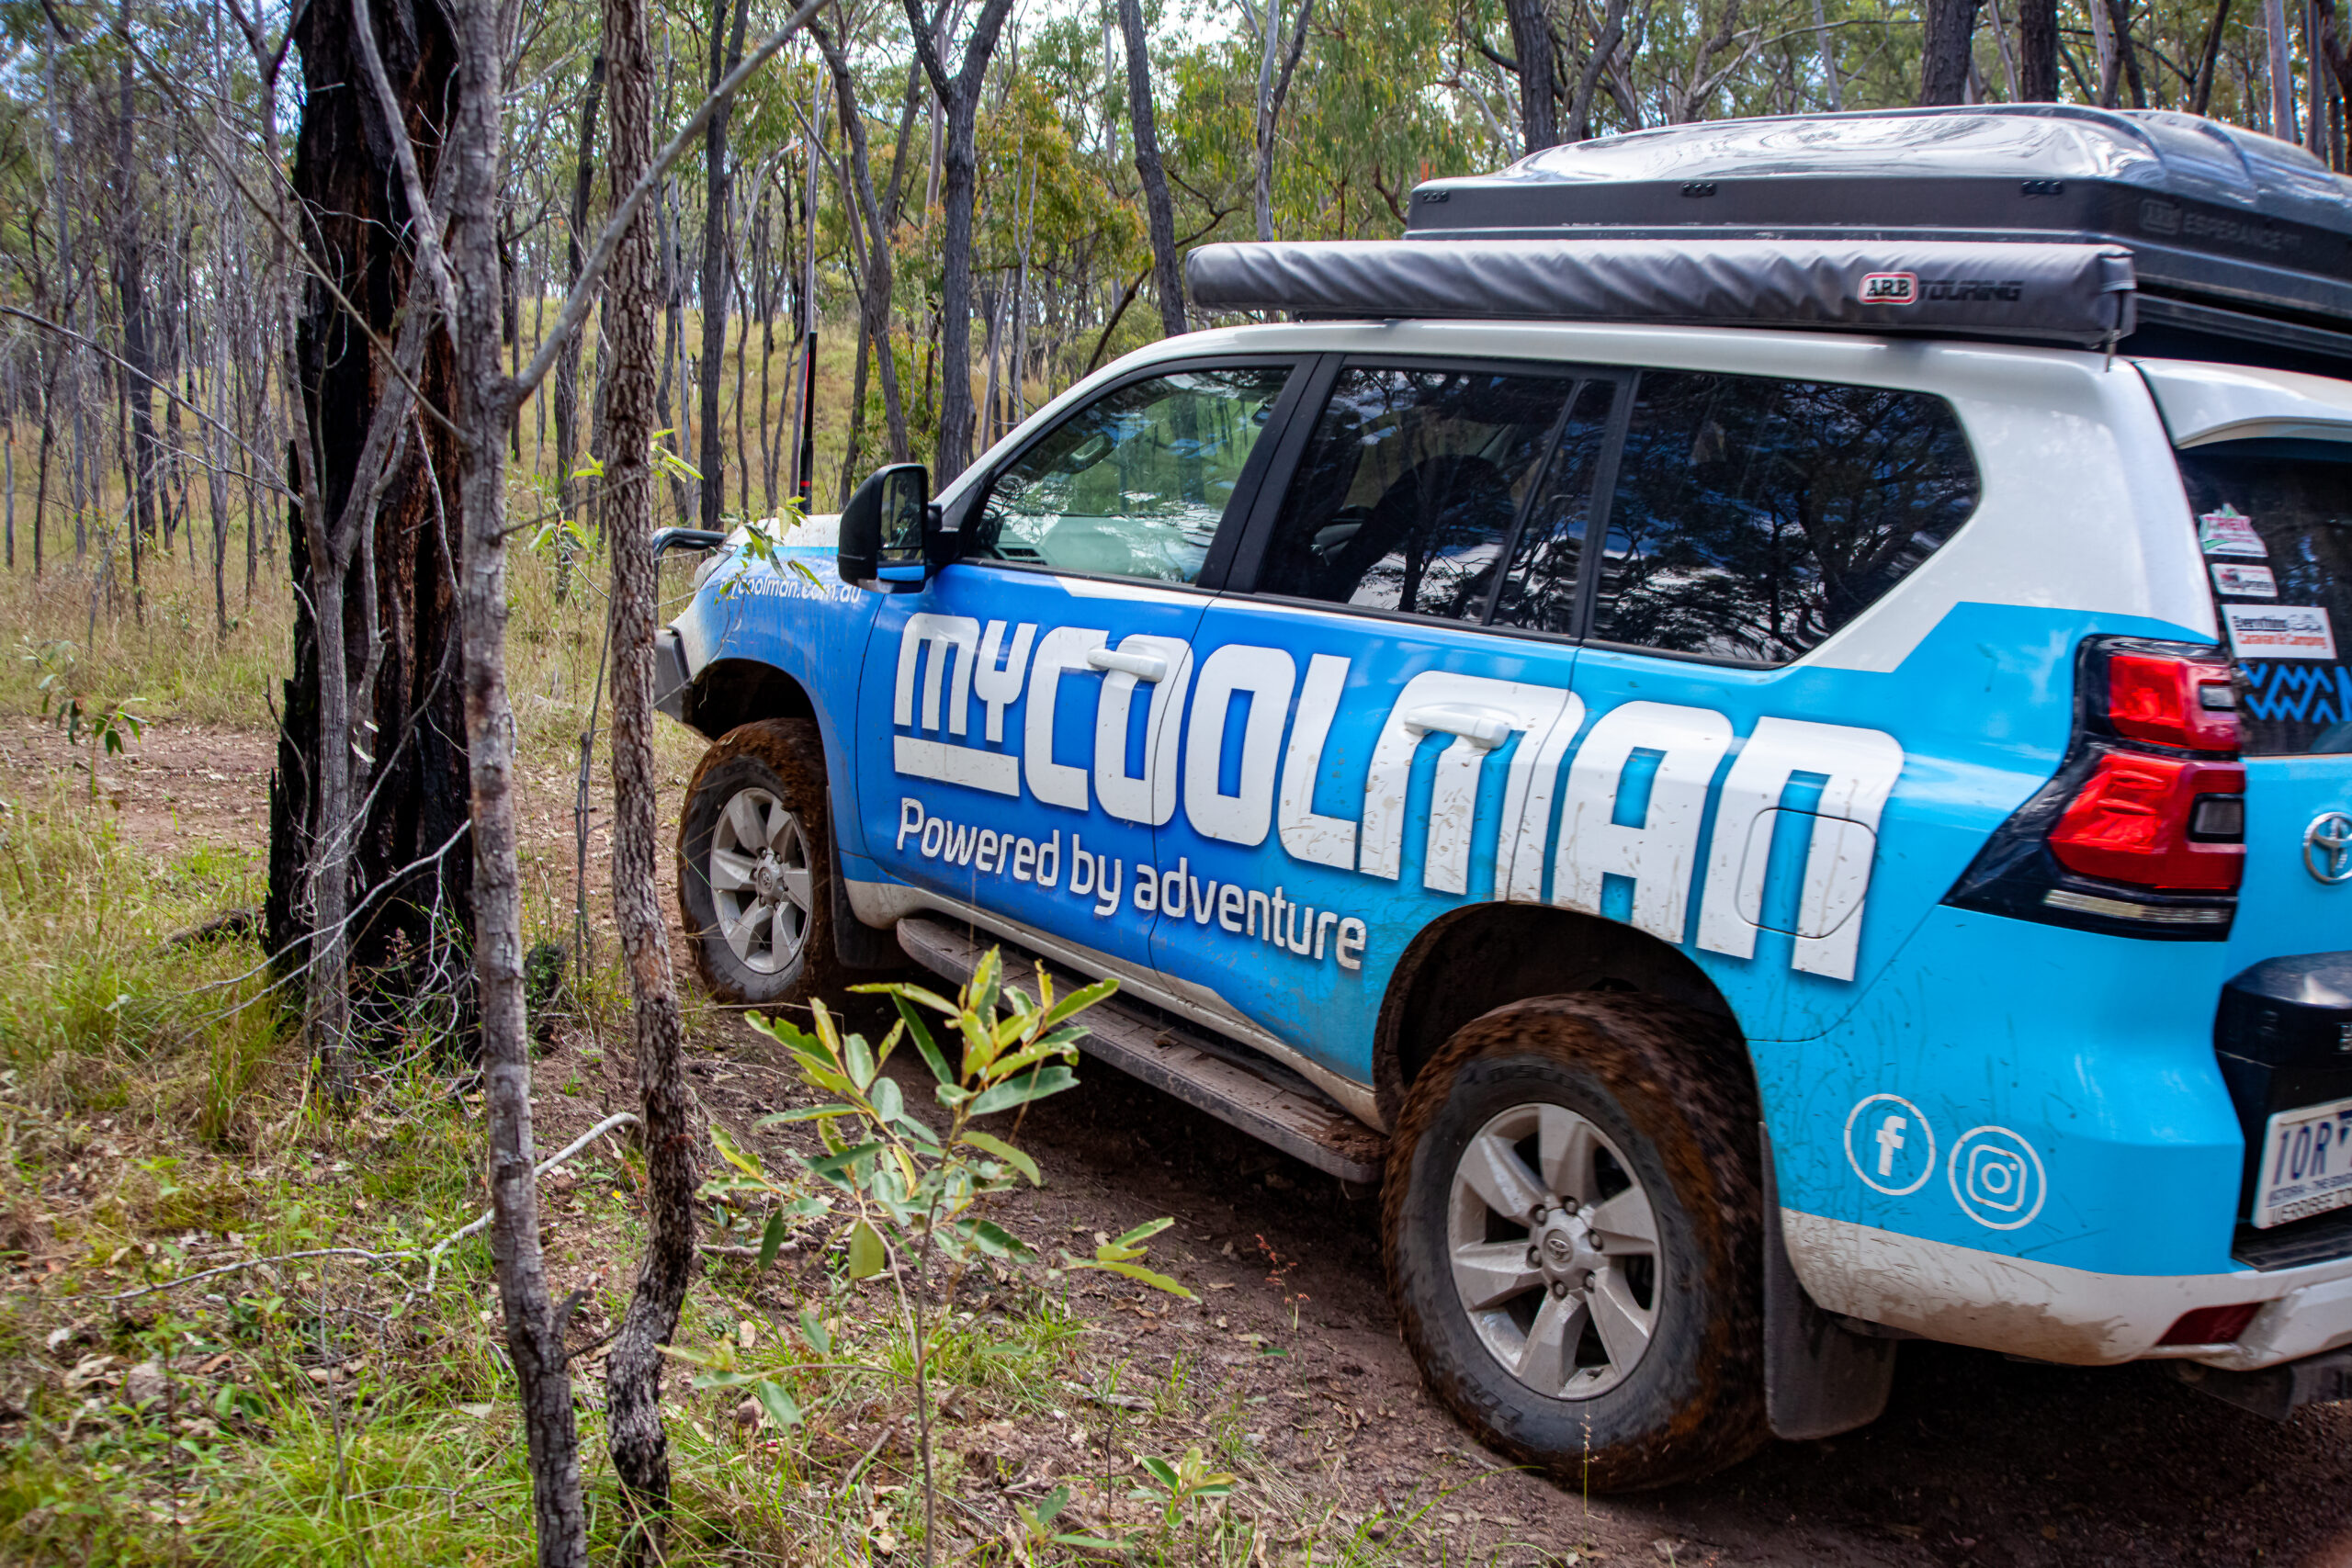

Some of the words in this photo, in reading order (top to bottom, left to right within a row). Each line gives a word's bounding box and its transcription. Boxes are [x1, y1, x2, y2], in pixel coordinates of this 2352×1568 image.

[1918, 280, 2025, 301] TOURING
[894, 612, 1905, 982] MYCOOLMAN
[897, 797, 1060, 886] Powered
[1069, 834, 1123, 916] by
[1134, 857, 1367, 970] adventure
